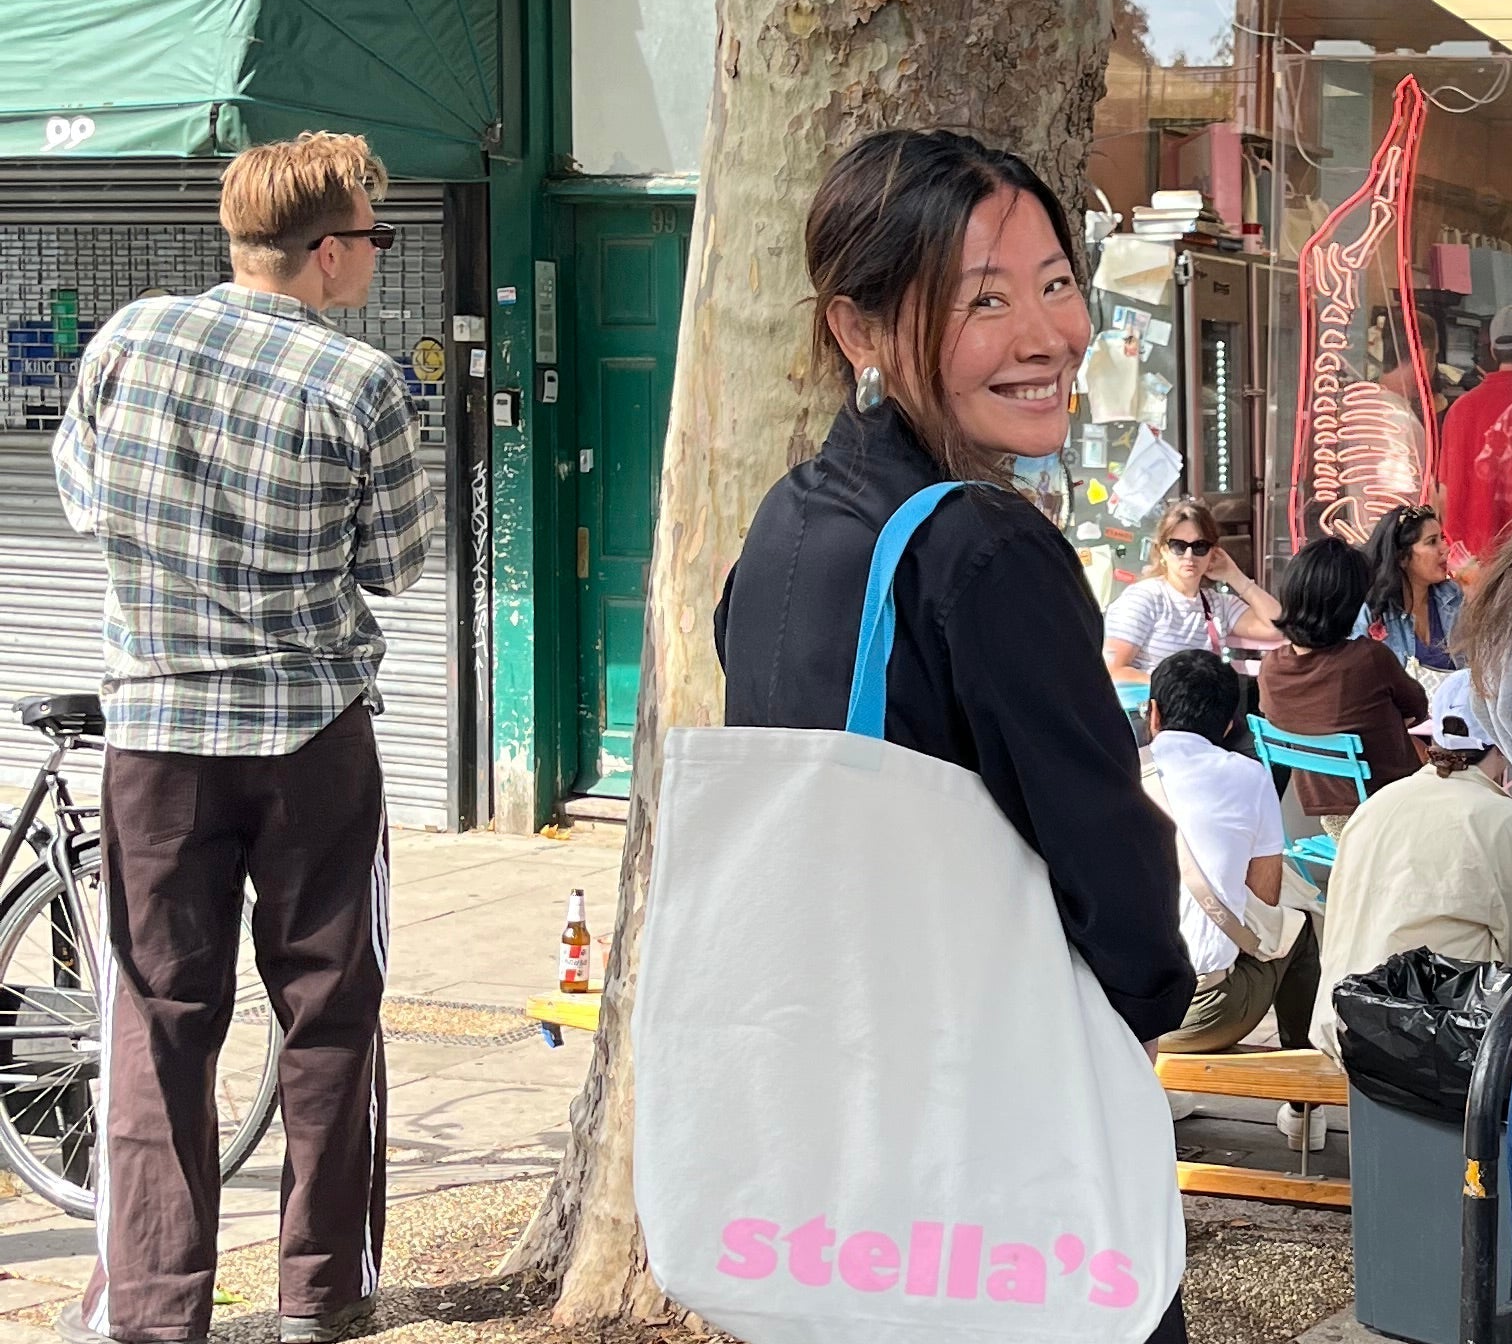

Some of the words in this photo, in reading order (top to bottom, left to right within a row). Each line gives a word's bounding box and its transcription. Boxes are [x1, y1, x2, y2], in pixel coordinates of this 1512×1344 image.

[40, 115, 96, 152] 99
[651, 206, 677, 234] 99
[715, 1213, 1139, 1309] stella's
